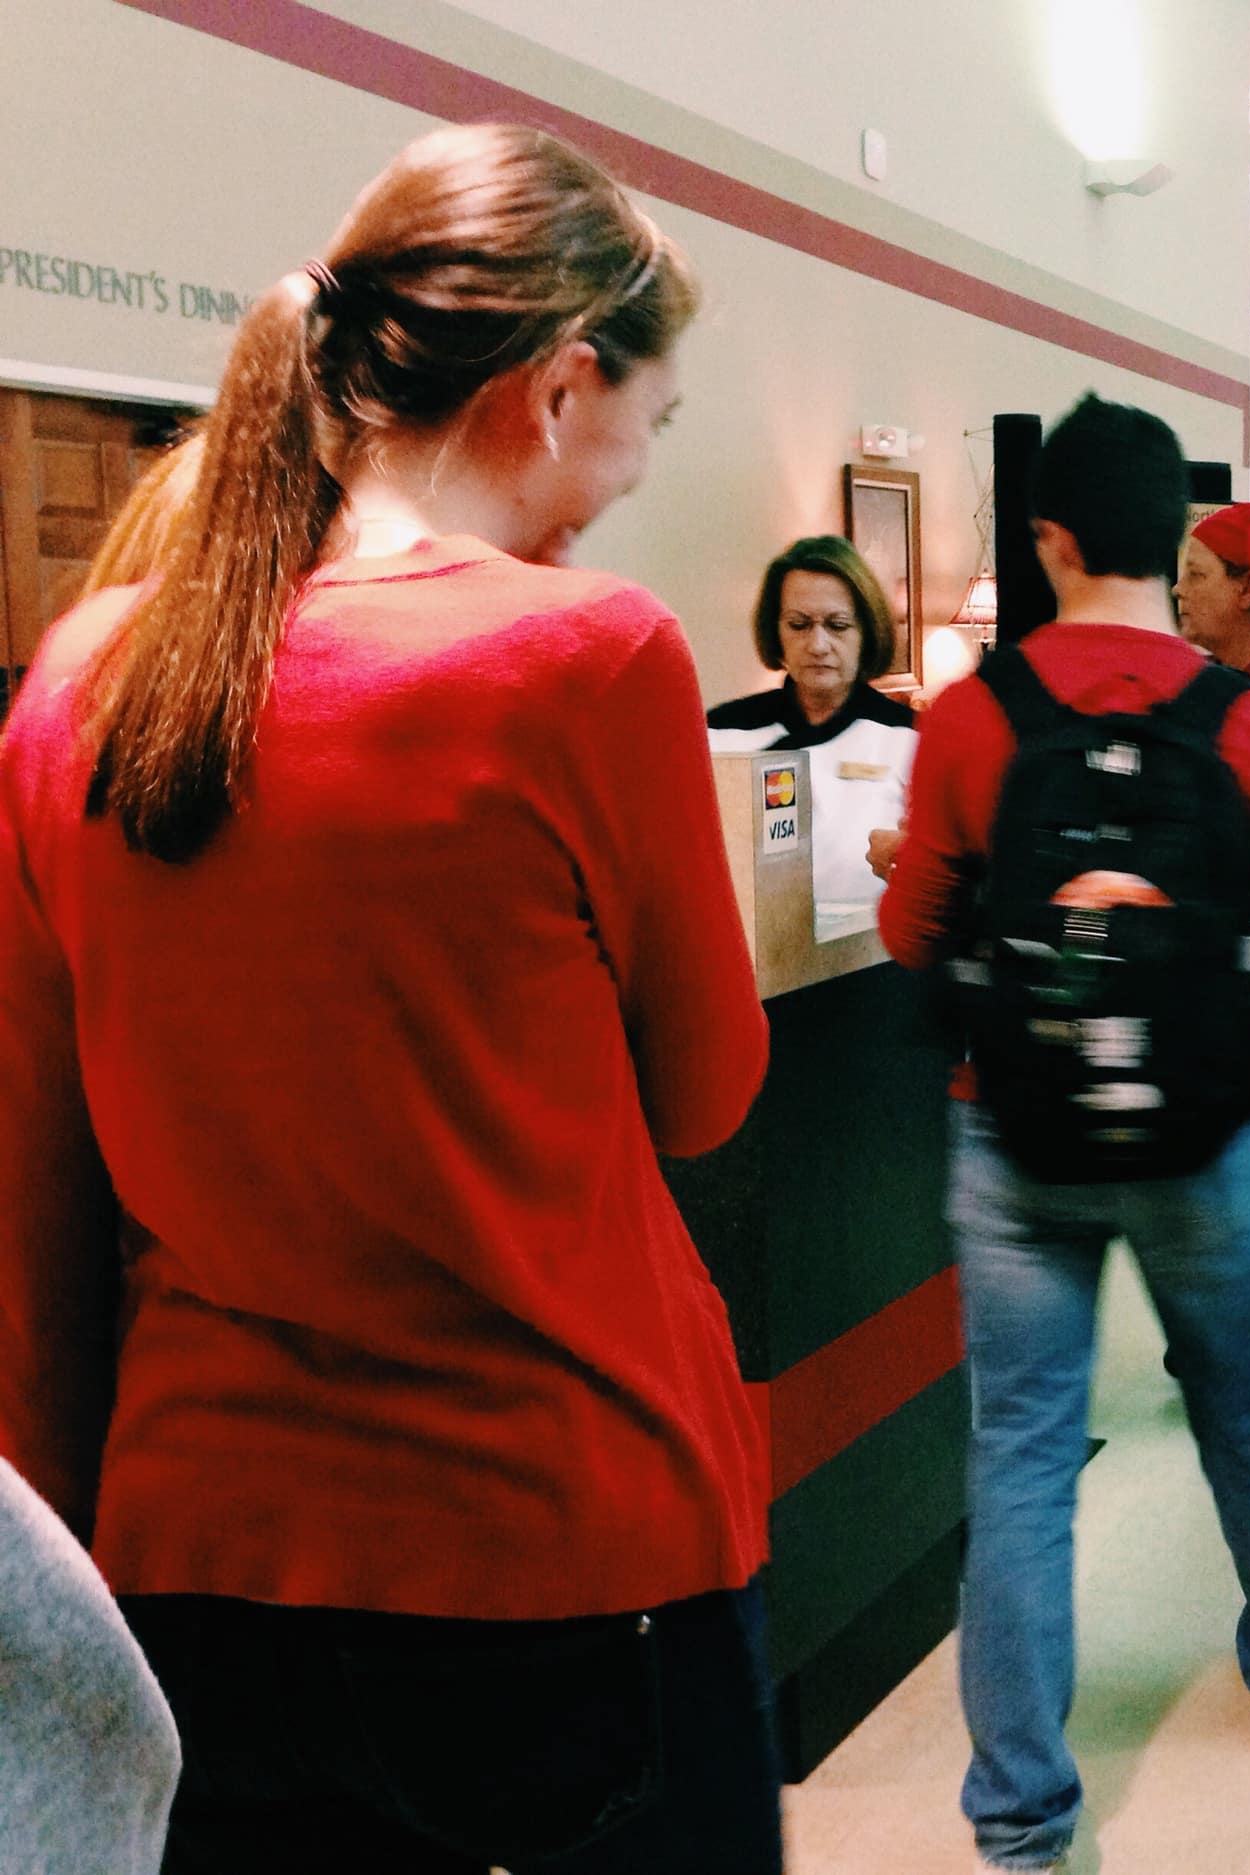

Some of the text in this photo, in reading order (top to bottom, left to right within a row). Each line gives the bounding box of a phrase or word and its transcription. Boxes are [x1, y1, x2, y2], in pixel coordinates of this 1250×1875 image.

[0, 248, 254, 325] PRESIDENT'S DININ
[769, 819, 795, 840] VISA
